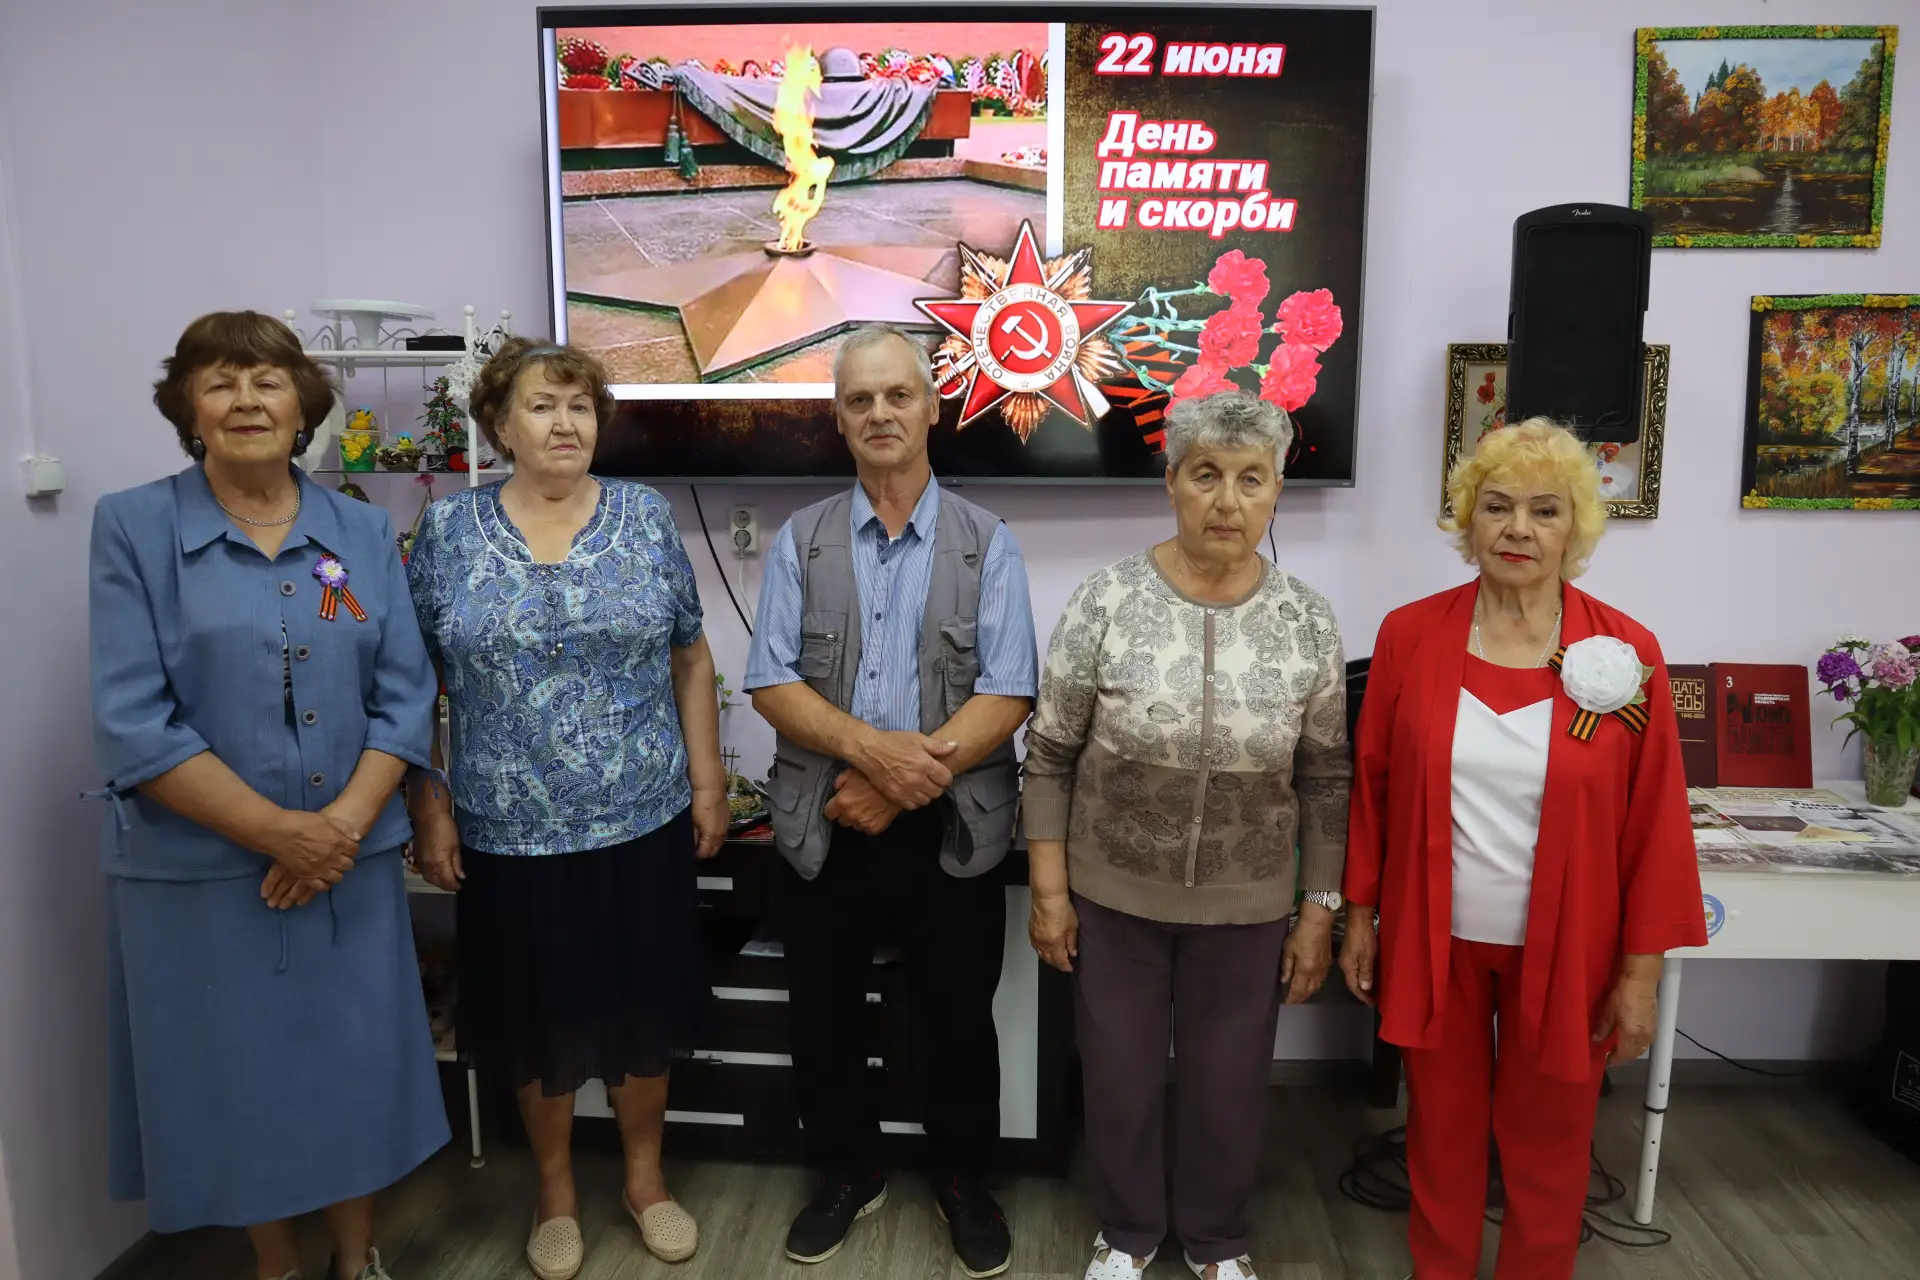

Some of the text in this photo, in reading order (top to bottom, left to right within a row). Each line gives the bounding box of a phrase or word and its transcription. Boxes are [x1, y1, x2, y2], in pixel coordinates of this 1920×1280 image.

[1096, 33, 1285, 76] 22 июня
[1097, 112, 1215, 157] День
[1098, 160, 1267, 190] памяти
[1098, 190, 1296, 237] и скорби
[975, 287, 1078, 381] ОТЕЧЕСТВЕННАЯ ВОЙНА
[1669, 681, 1705, 695] ДАТЫ
[1726, 676, 1733, 688] 3
